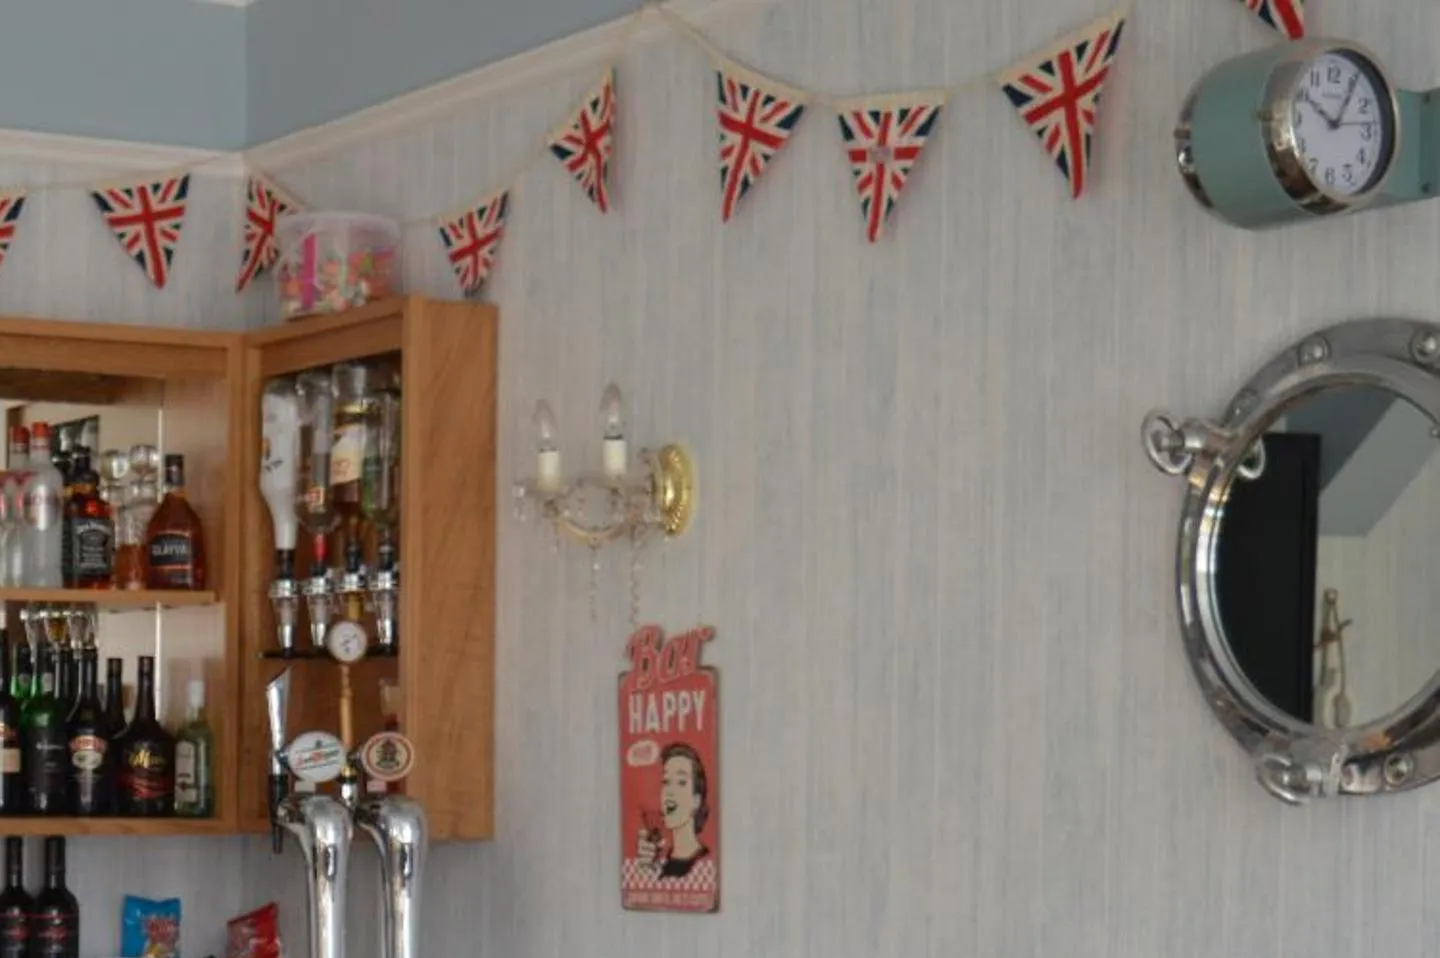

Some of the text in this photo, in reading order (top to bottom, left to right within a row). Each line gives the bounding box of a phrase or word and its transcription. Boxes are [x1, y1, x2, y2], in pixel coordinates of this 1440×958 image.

[1310, 69, 1320, 87] 11
[1327, 66, 1341, 84] 12
[1358, 98, 1370, 114] 2
[1360, 124, 1372, 141] 3
[1356, 148, 1367, 164] 4
[1308, 158, 1319, 175] 7
[1325, 168, 1336, 185] 6
[629, 690, 705, 734] HAPPY
